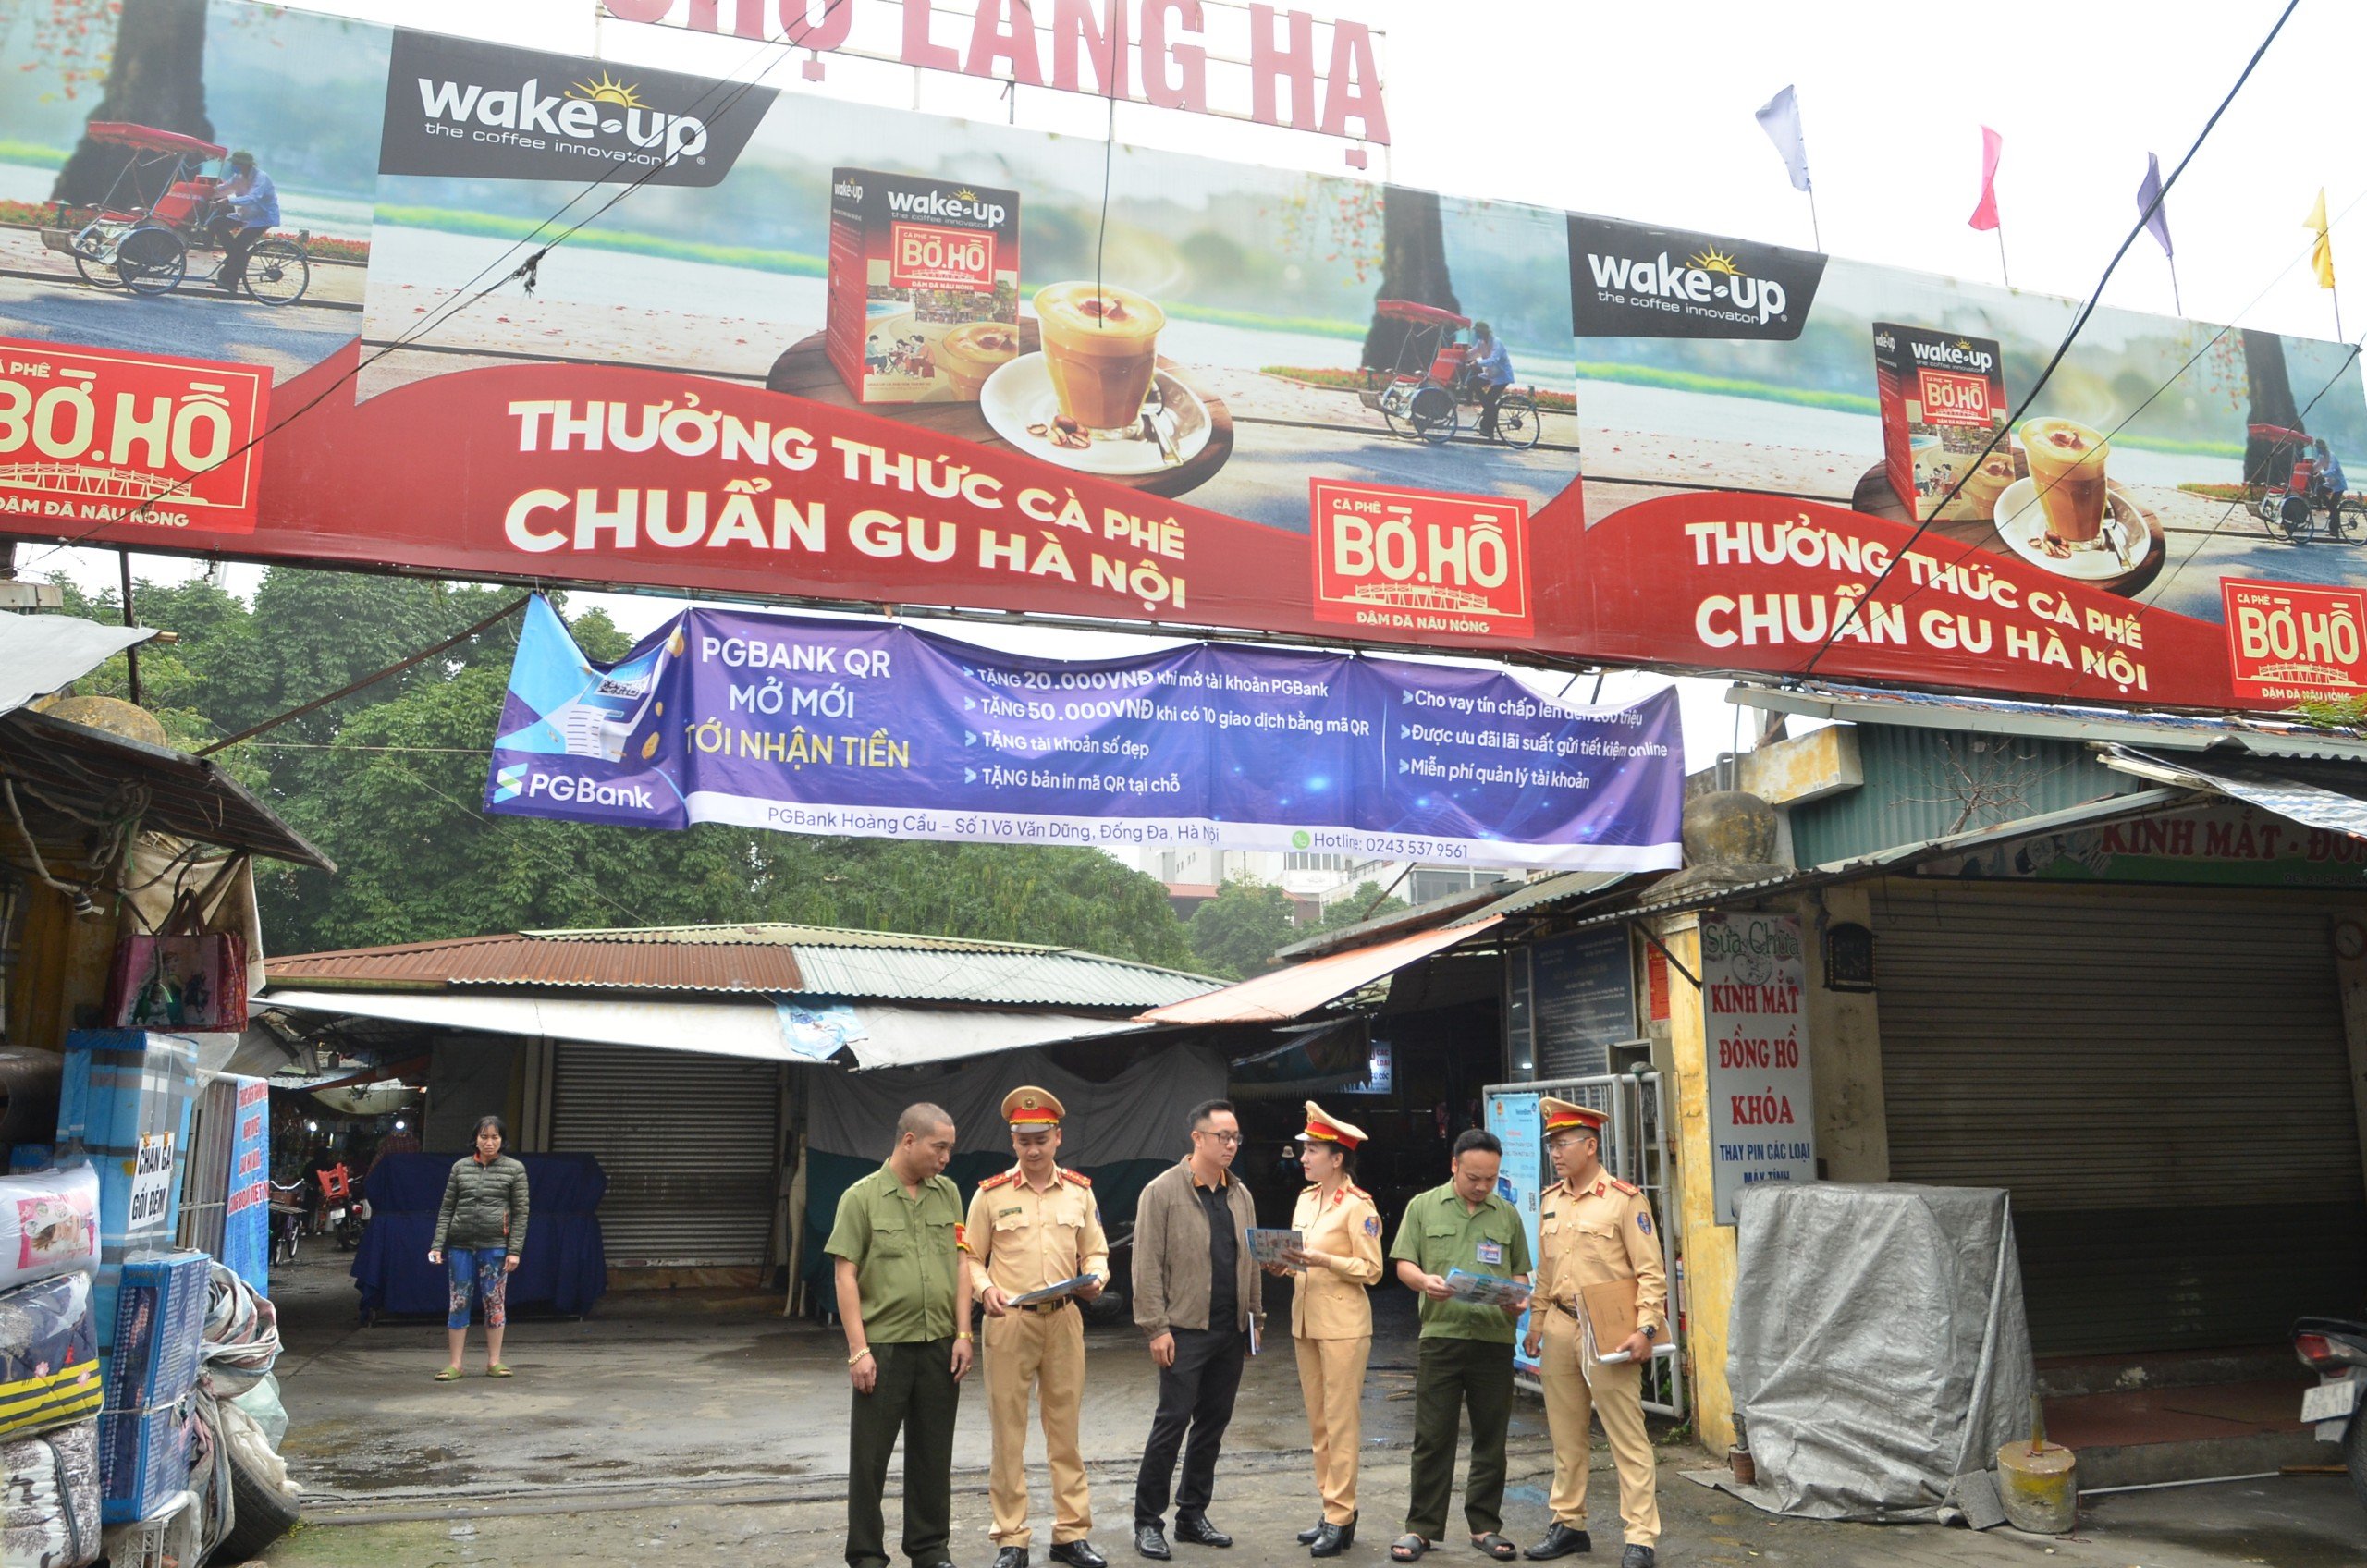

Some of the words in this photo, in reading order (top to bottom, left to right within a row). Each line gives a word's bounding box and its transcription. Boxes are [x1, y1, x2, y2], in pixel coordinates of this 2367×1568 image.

[1250, 3, 1390, 170] HẠ
[425, 121, 464, 138] the
[472, 129, 546, 150] coffee
[555, 139, 662, 165] innovator
[891, 212, 909, 220] the
[911, 214, 942, 223] coffee
[944, 216, 988, 228] innovator
[1598, 291, 1625, 304] the
[1630, 297, 1680, 312] coffee
[1686, 303, 1759, 324] innovator
[10, 361, 51, 378] PHÊ
[508, 392, 818, 471] THƯỞNG
[832, 436, 1004, 509] THỨC
[1017, 487, 1093, 534] CÀ
[1103, 508, 1184, 560] PHÊ
[45, 500, 75, 518] ĐÀ
[80, 501, 125, 521] NÂU
[1355, 501, 1381, 514] PHÊ
[505, 477, 826, 553] CHUẨN
[848, 509, 956, 563] GU
[979, 530, 1076, 582] HÀ
[1091, 553, 1185, 611] NỘI
[1685, 513, 1894, 577] THƯỞNG
[1901, 550, 2019, 609] THỨC
[2027, 591, 2080, 630] CÀ
[2085, 607, 2143, 650] PHÊ
[1356, 610, 1390, 627] ĐẬM
[1417, 615, 1446, 631] NÂU
[1696, 583, 1907, 648] CHUẨN
[1919, 609, 1992, 654] GU
[2005, 625, 2073, 669] HÀ
[2080, 645, 2148, 693] NỘI
[702, 636, 837, 673] PGBANK
[843, 649, 890, 679] QR
[729, 676, 783, 714] MỞ
[792, 682, 853, 718] MỚI
[977, 668, 1022, 687] TẶNG
[1157, 671, 1178, 686] khi
[1179, 670, 1203, 687] mở
[1205, 674, 1222, 690] tài
[1226, 675, 1269, 693] khoản
[1272, 679, 1329, 697] PGBank
[981, 696, 1025, 718] TẶNG
[1156, 705, 1177, 721] khi
[1180, 706, 1200, 722] có
[1219, 711, 1251, 729] giao
[1254, 712, 1285, 731] dịch
[1288, 710, 1323, 735] bằng
[1326, 717, 1349, 732] mã
[1350, 719, 1369, 736] QR
[1415, 690, 1446, 708] Cho
[1448, 696, 1475, 715] vay
[1477, 695, 1496, 713] tín
[1498, 697, 1536, 719] chấp
[1620, 709, 1643, 729] triệu
[740, 725, 833, 770] NHẬN
[840, 728, 909, 768] TIỀN
[982, 730, 1027, 752] TẶNG
[1030, 738, 1051, 751] tài
[1053, 735, 1099, 753] khoản
[1102, 735, 1121, 754] số
[1121, 740, 1149, 759] đẹp
[1412, 724, 1453, 746] Được
[1456, 730, 1475, 745] ưu
[1478, 730, 1500, 748] đãi
[1502, 731, 1520, 750] lãi
[1522, 732, 1554, 753] suất
[1556, 736, 1579, 757] gửi
[1581, 737, 1601, 756] tiết
[1602, 741, 1627, 761] kiệm
[1628, 741, 1668, 757] online
[982, 765, 1028, 789] TẶNG
[1031, 770, 1060, 789] bản
[1062, 772, 1075, 789] in
[1078, 774, 1100, 790] mã
[1103, 775, 1125, 792] QR
[1128, 777, 1148, 796] tại
[1150, 773, 1180, 792] chỗ
[1411, 755, 1446, 778] Miễn
[1448, 763, 1475, 781] phí
[1476, 765, 1513, 784] quản
[1515, 767, 1528, 788] lý
[1531, 771, 1550, 786] tài
[1551, 771, 1590, 790] khoản
[529, 774, 654, 809] PGBank
[768, 807, 837, 827] PGBank
[842, 813, 898, 834] Hoàng
[903, 814, 937, 832] Cầu
[955, 815, 977, 834] Số
[992, 819, 1012, 836] Võ
[1017, 822, 1045, 837] Văn
[1050, 822, 1096, 842] Dũng,
[1100, 822, 1143, 842] Đống
[1178, 825, 1199, 839] Hà
[1366, 838, 1404, 854] 0243
[1407, 840, 1433, 856] 537
[1438, 843, 1468, 859] 9561
[1711, 975, 1758, 1013] KÍNH
[1761, 969, 1799, 1013] MẮT
[1719, 1023, 1771, 1069] ĐỒNG
[1774, 1024, 1798, 1069] HỒ
[1731, 1086, 1795, 1125] KHÓA
[139, 1142, 161, 1175] CHĂN
[161, 1145, 171, 1170] GA
[1720, 1145, 1744, 1161] THAY
[1748, 1144, 1764, 1160] PIN
[1767, 1140, 1786, 1159] CÁC
[1789, 1143, 1809, 1163] LOẠI
[132, 1183, 148, 1220] GỐI
[149, 1184, 166, 1220] ĐỆM
